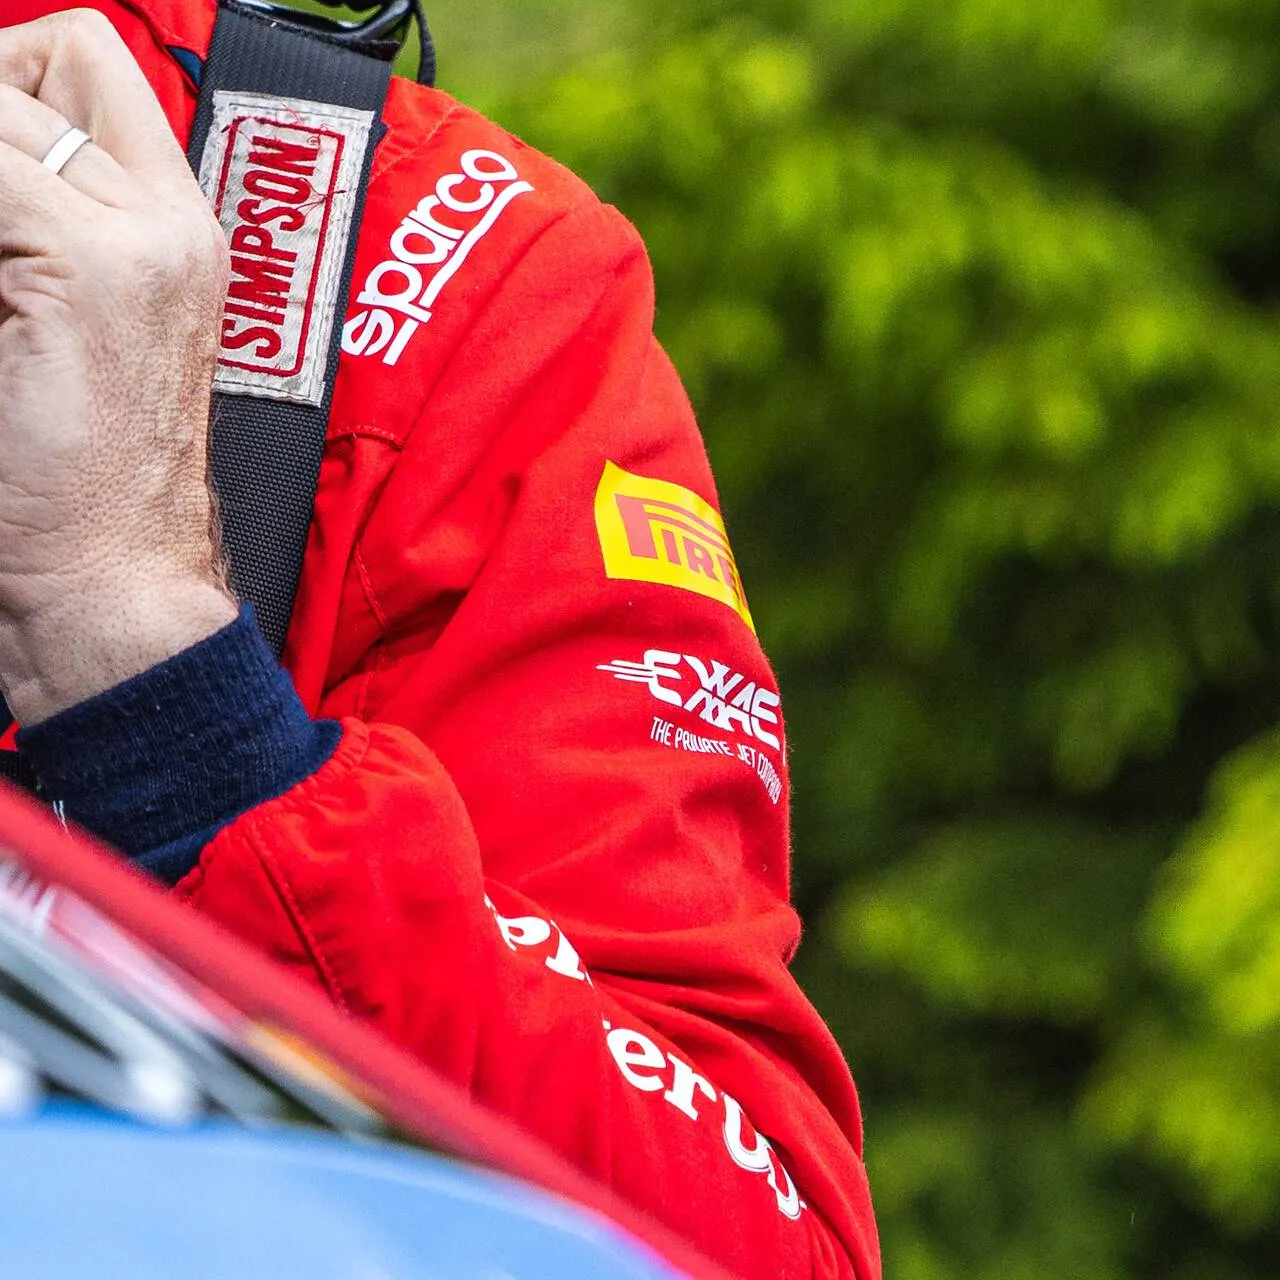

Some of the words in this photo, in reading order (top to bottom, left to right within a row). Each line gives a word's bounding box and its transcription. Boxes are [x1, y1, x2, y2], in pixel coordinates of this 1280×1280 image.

[220, 135, 319, 359] SIMPSON
[340, 149, 520, 360] sparco
[650, 716, 675, 746] THE
[674, 727, 735, 757] PRIVATE
[736, 743, 757, 768] JET
